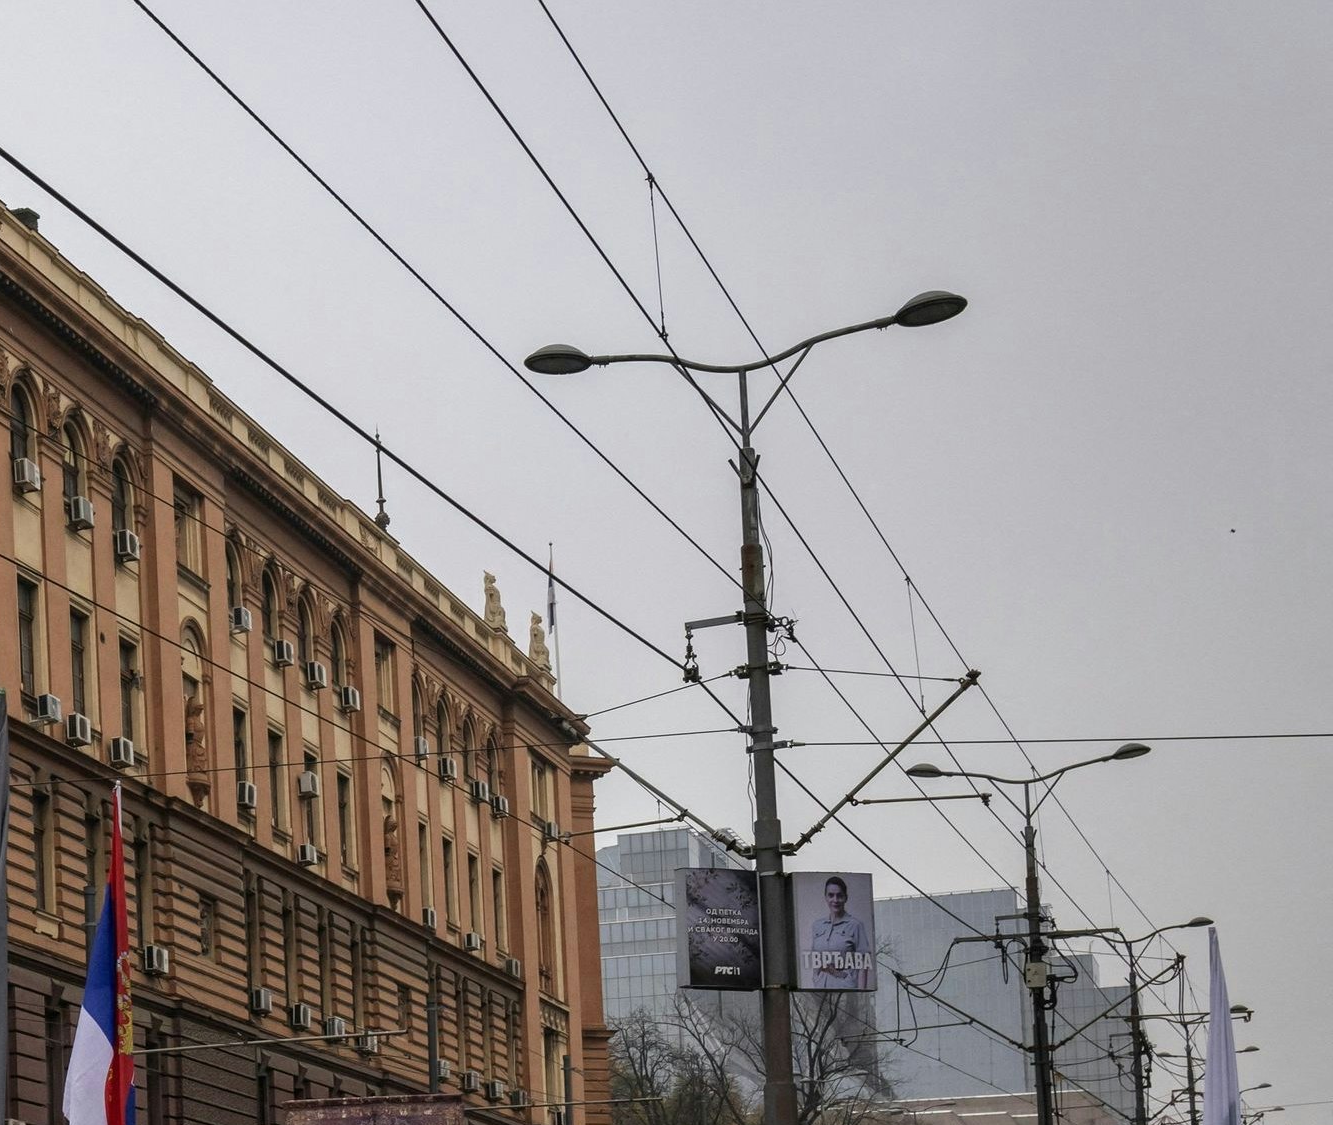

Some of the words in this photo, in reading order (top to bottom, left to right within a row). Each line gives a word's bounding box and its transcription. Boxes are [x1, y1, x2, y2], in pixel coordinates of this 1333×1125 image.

[705, 908, 718, 916] ОД
[718, 908, 742, 916] ПЕТКА
[710, 917, 749, 926] НОВЕМБРА
[726, 927, 759, 936] ВИКЕНДА
[802, 951, 873, 970] ТВРЂАВА
